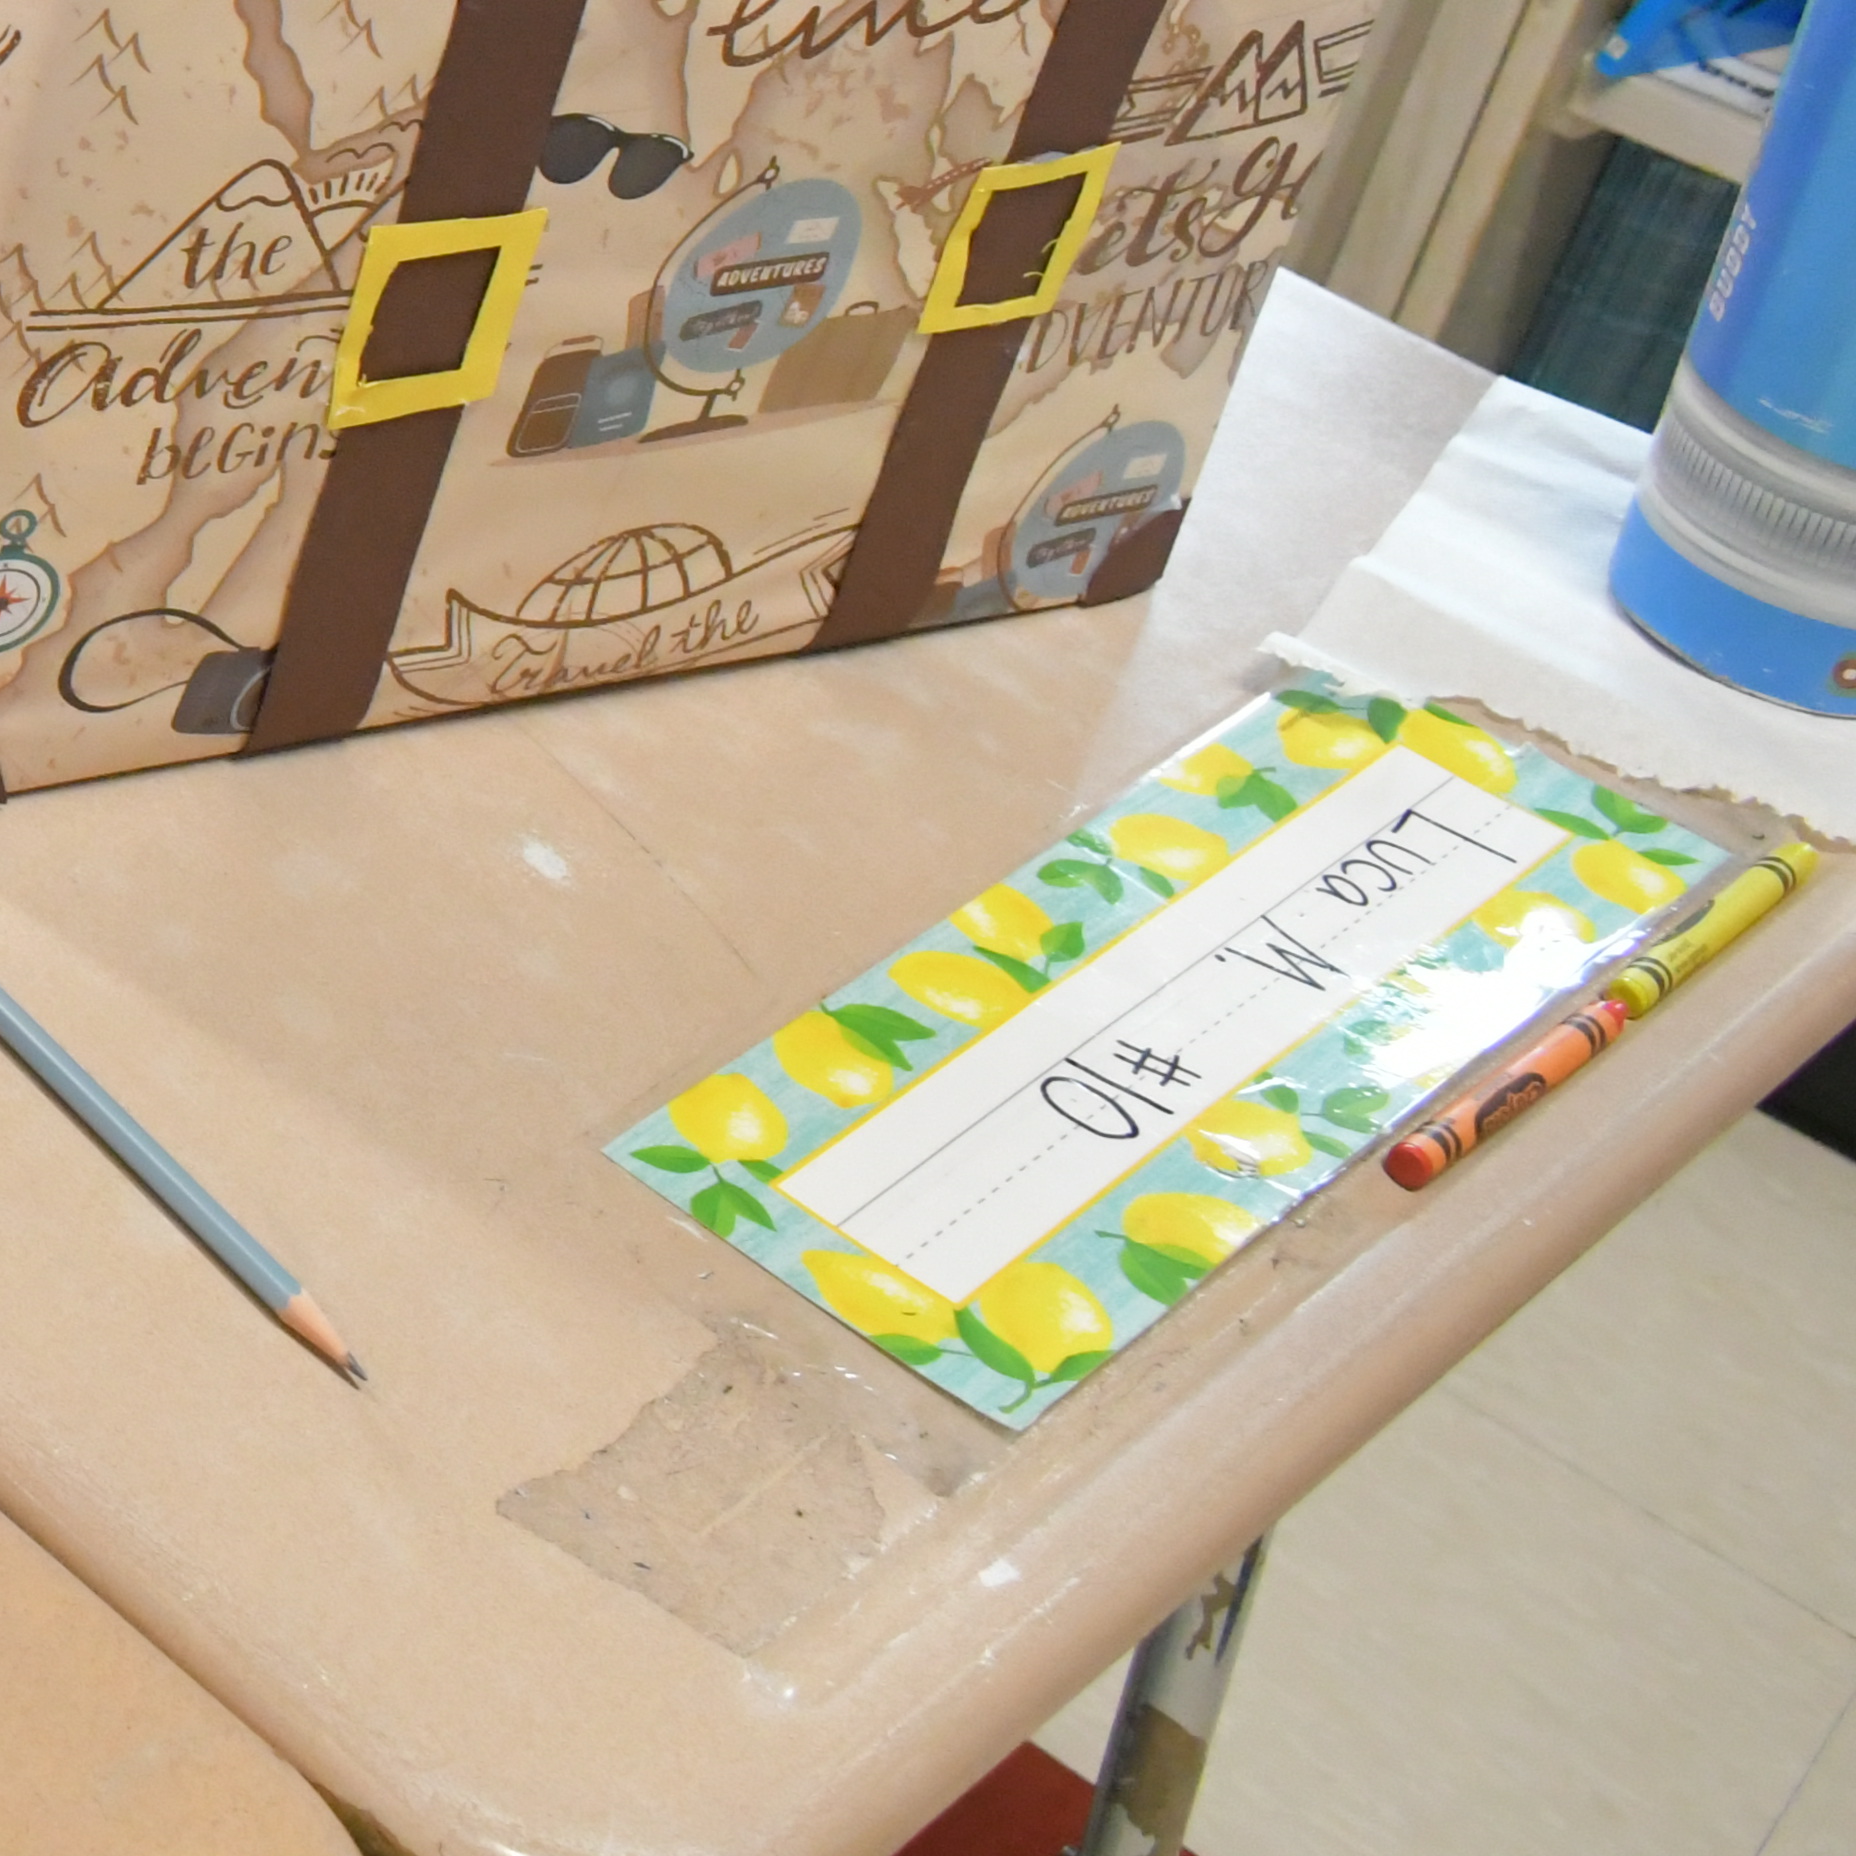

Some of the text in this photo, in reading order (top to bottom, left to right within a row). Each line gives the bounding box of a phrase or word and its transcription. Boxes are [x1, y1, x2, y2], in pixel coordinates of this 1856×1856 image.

[180, 220, 294, 290] the
[715, 256, 829, 290] ADVENTURES
[668, 598, 760, 655] the
[1039, 808, 1518, 1141] Luca M. #10
